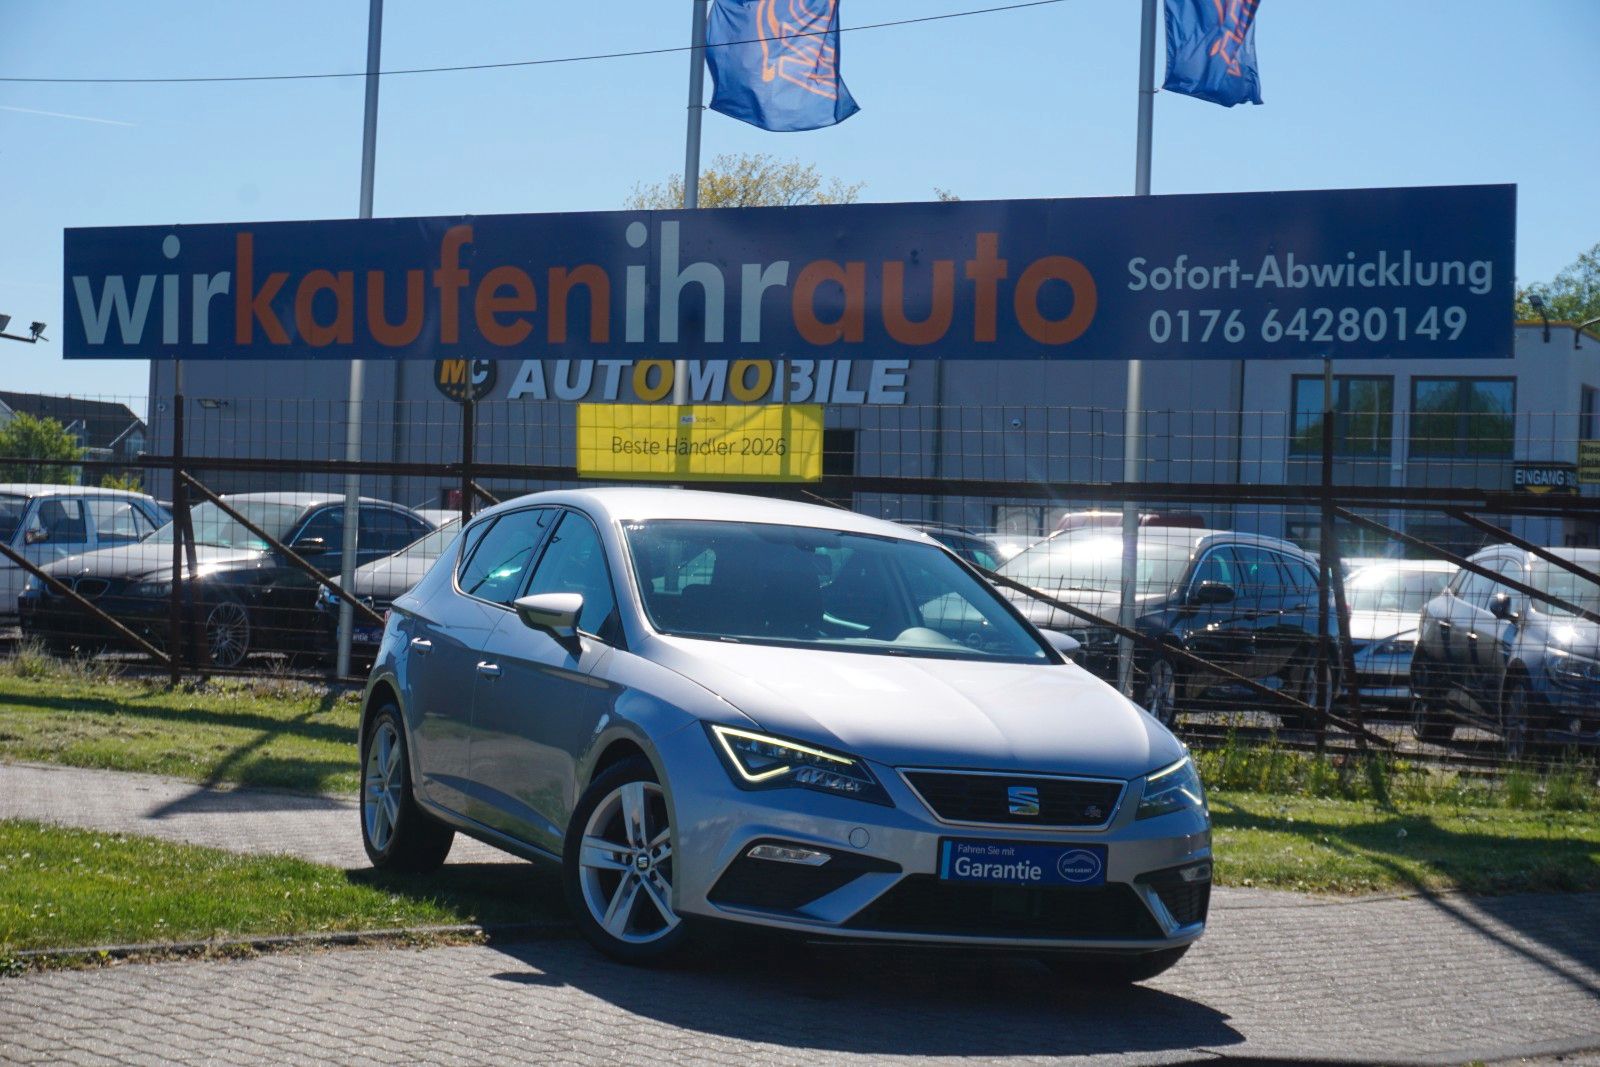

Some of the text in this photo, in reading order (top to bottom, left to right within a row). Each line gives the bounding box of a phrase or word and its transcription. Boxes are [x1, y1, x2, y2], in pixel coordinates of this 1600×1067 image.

[1127, 250, 1493, 294] Sofort-Abwicklung
[1149, 306, 1467, 343] 0176 64280149
[506, 359, 909, 405] AUTOMOBILE
[611, 435, 786, 456] Beste Händler 2026
[1515, 469, 1564, 485] EINGANG
[958, 844, 1015, 856] Fahren Sie mit
[955, 857, 1041, 880] Garantie
